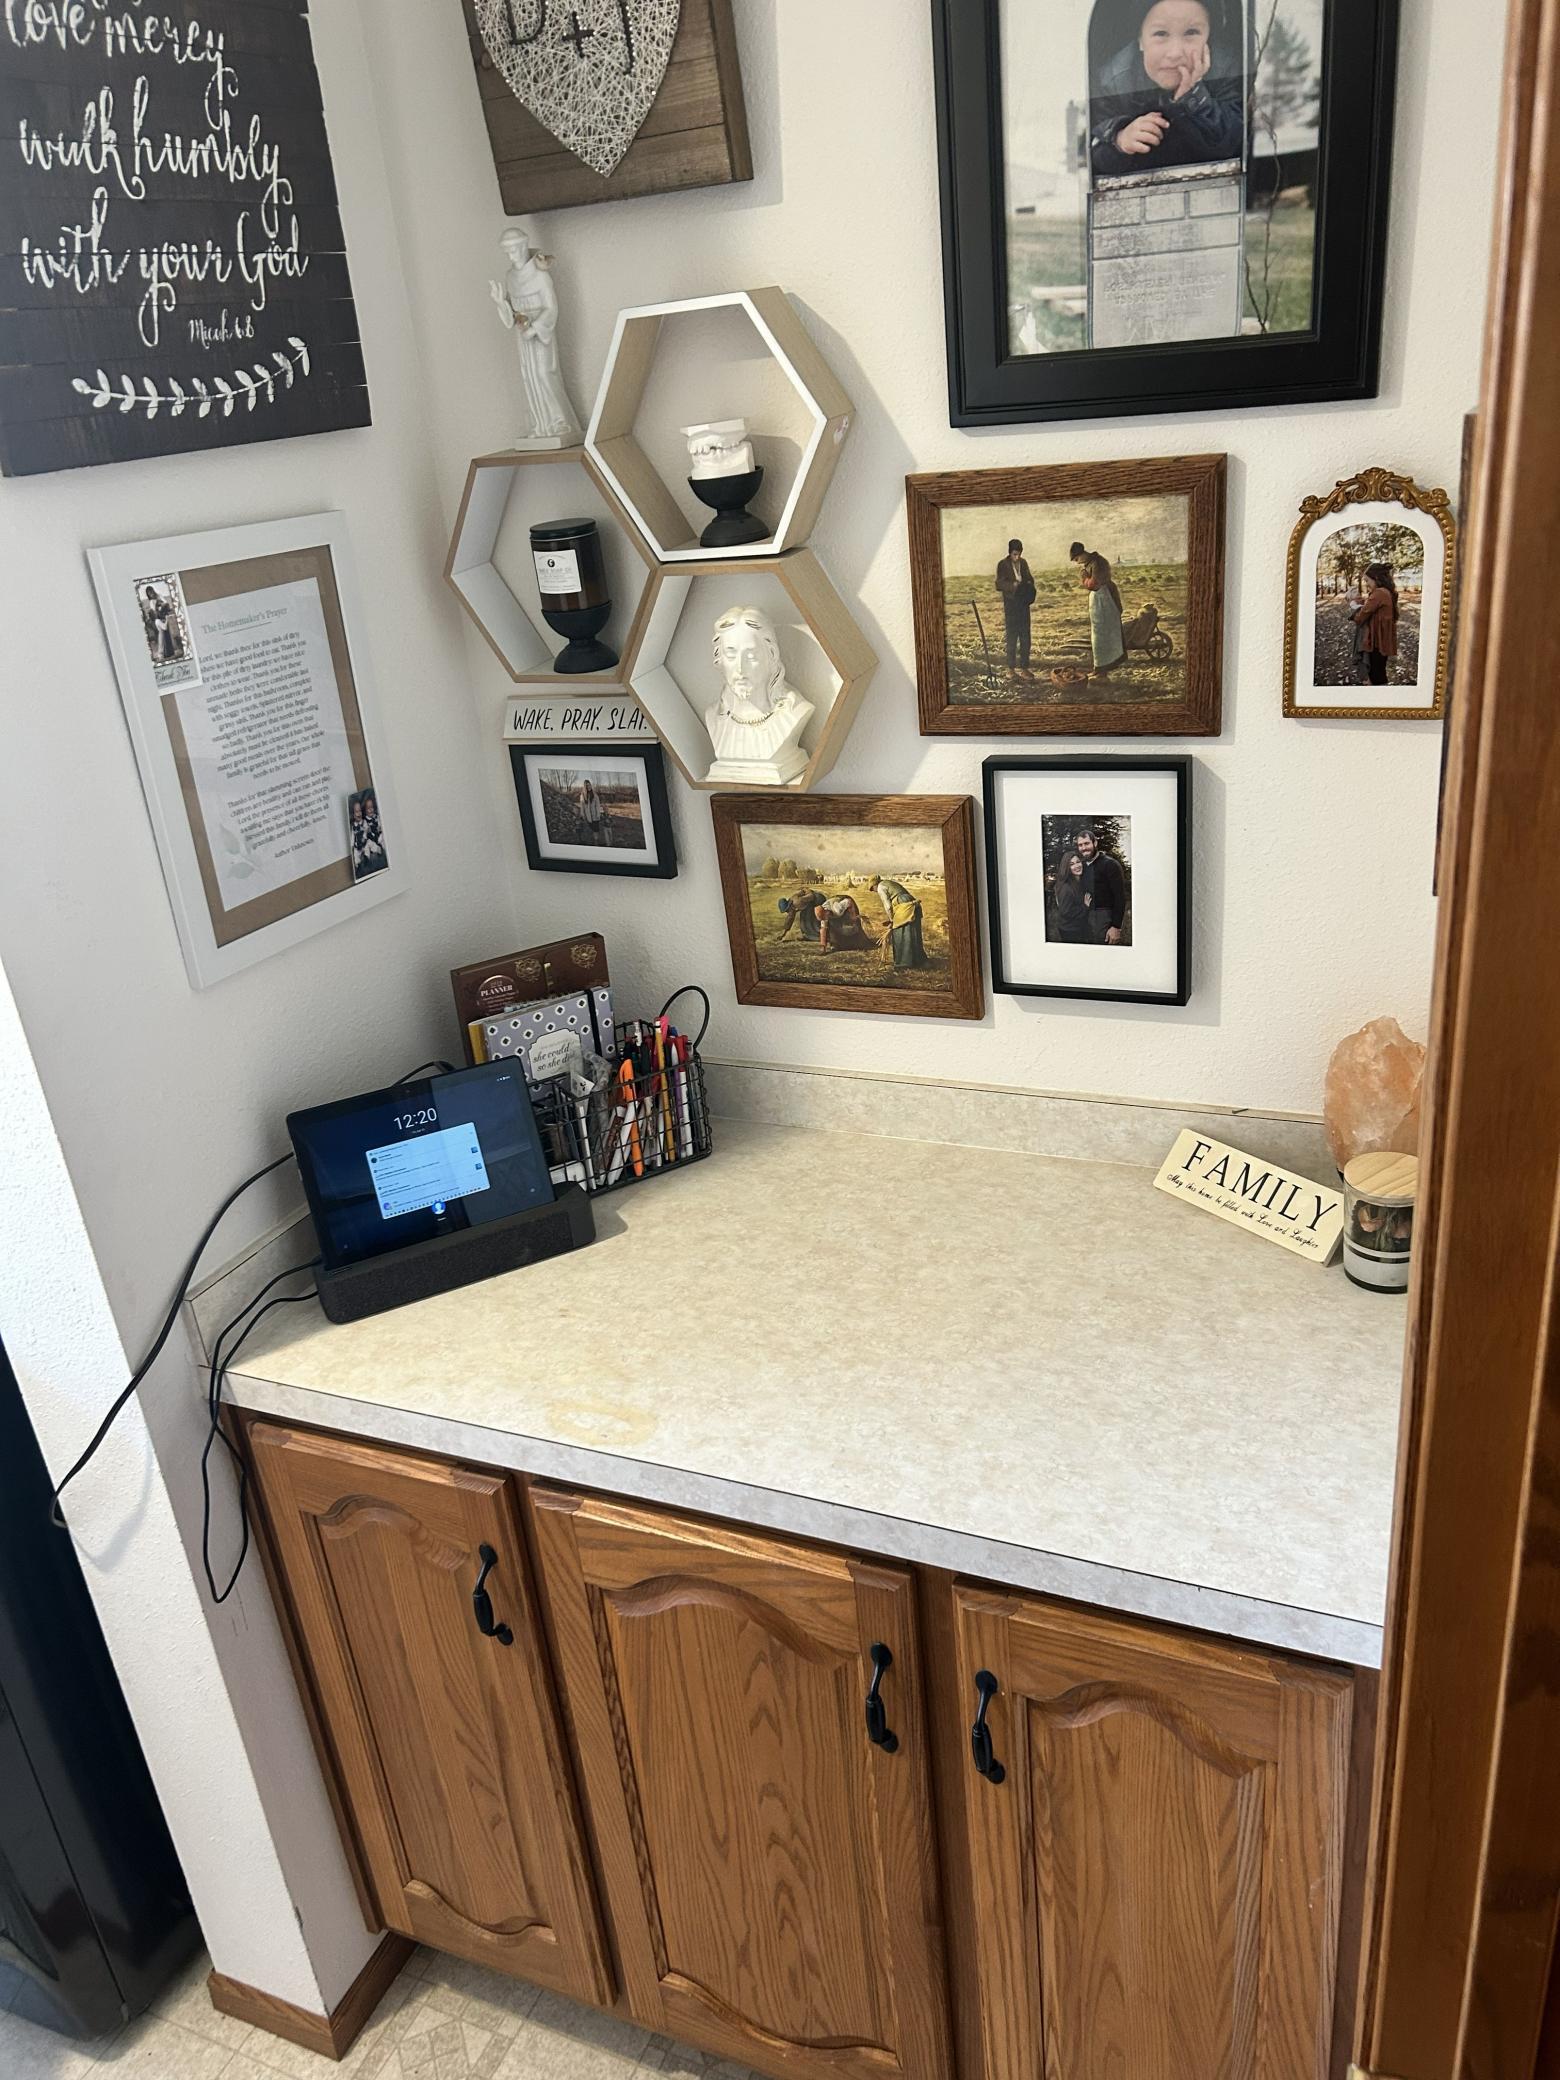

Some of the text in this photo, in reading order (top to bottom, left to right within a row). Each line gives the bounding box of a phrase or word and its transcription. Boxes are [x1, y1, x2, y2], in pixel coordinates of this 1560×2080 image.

[105, 12, 239, 130] mercy
[134, 76, 292, 238] humbly
[22, 187, 310, 347] with your God
[203, 623, 217, 634] The
[266, 607, 288, 618] Prayer
[513, 707, 554, 731] WAKE.
[561, 705, 604, 731] PRAY.
[480, 984, 513, 997] PLANNER
[393, 1107, 437, 1130] 12:20
[1181, 1140, 1339, 1232] FAMILY
[1256, 1213, 1273, 1228] Love
